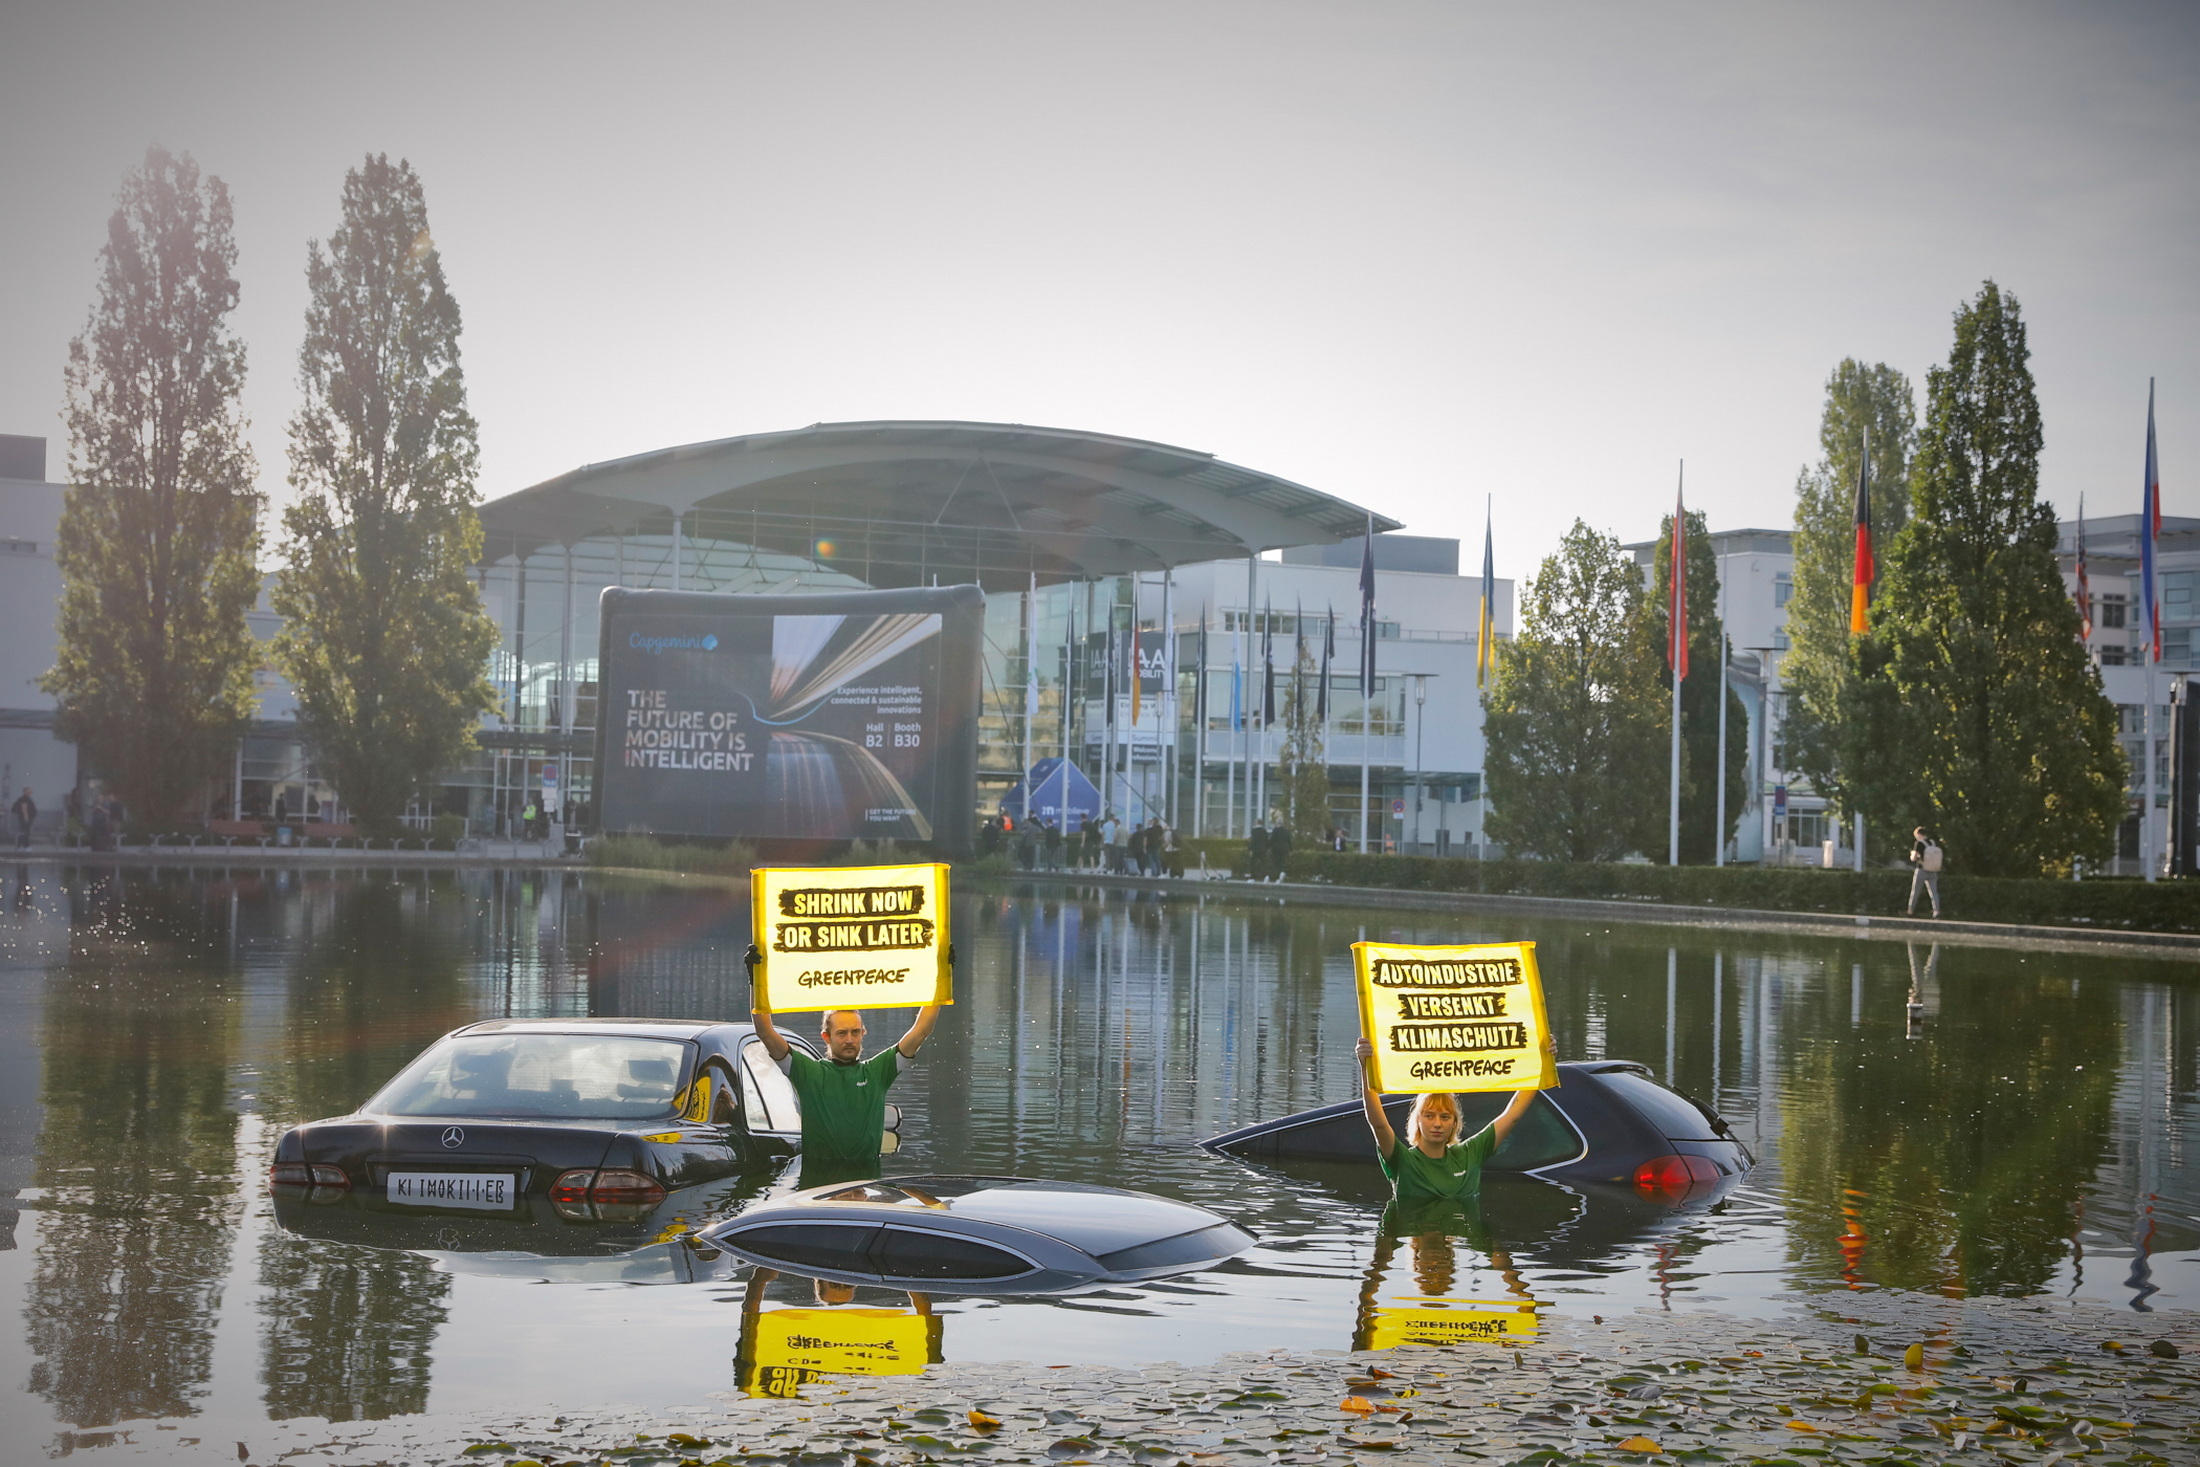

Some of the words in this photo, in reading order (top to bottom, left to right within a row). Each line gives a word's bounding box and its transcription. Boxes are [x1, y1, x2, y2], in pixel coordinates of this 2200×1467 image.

[629, 632, 702, 655] Capgemini
[627, 689, 667, 709] THE
[831, 695, 870, 705] connected
[871, 696, 877, 704] &
[878, 695, 922, 704] sustainable
[837, 686, 879, 696] Experience
[880, 685, 922, 696] intelligent,
[627, 709, 705, 730] FUTURE
[709, 711, 737, 730] OF
[877, 706, 922, 714] innovations
[866, 723, 884, 732] Hall
[894, 722, 921, 732] Booth
[626, 729, 723, 751] MOBILITY
[728, 732, 746, 751] IS
[866, 734, 883, 747] B2
[894, 734, 920, 747] B30
[625, 750, 754, 771] INTELLIGENT
[794, 891, 866, 915] SHRINK
[871, 890, 913, 912] NOW
[784, 925, 812, 948] OR
[817, 924, 863, 947] SINK
[867, 922, 924, 946] LATER
[797, 967, 910, 989] GREENPEACE
[1379, 962, 1516, 985] AUTOINDUSTRIE
[1406, 995, 1497, 1017] VERSENKT
[1396, 1026, 1520, 1050] KLIMASCHUTZ
[1410, 1058, 1516, 1081] GREENPEACE
